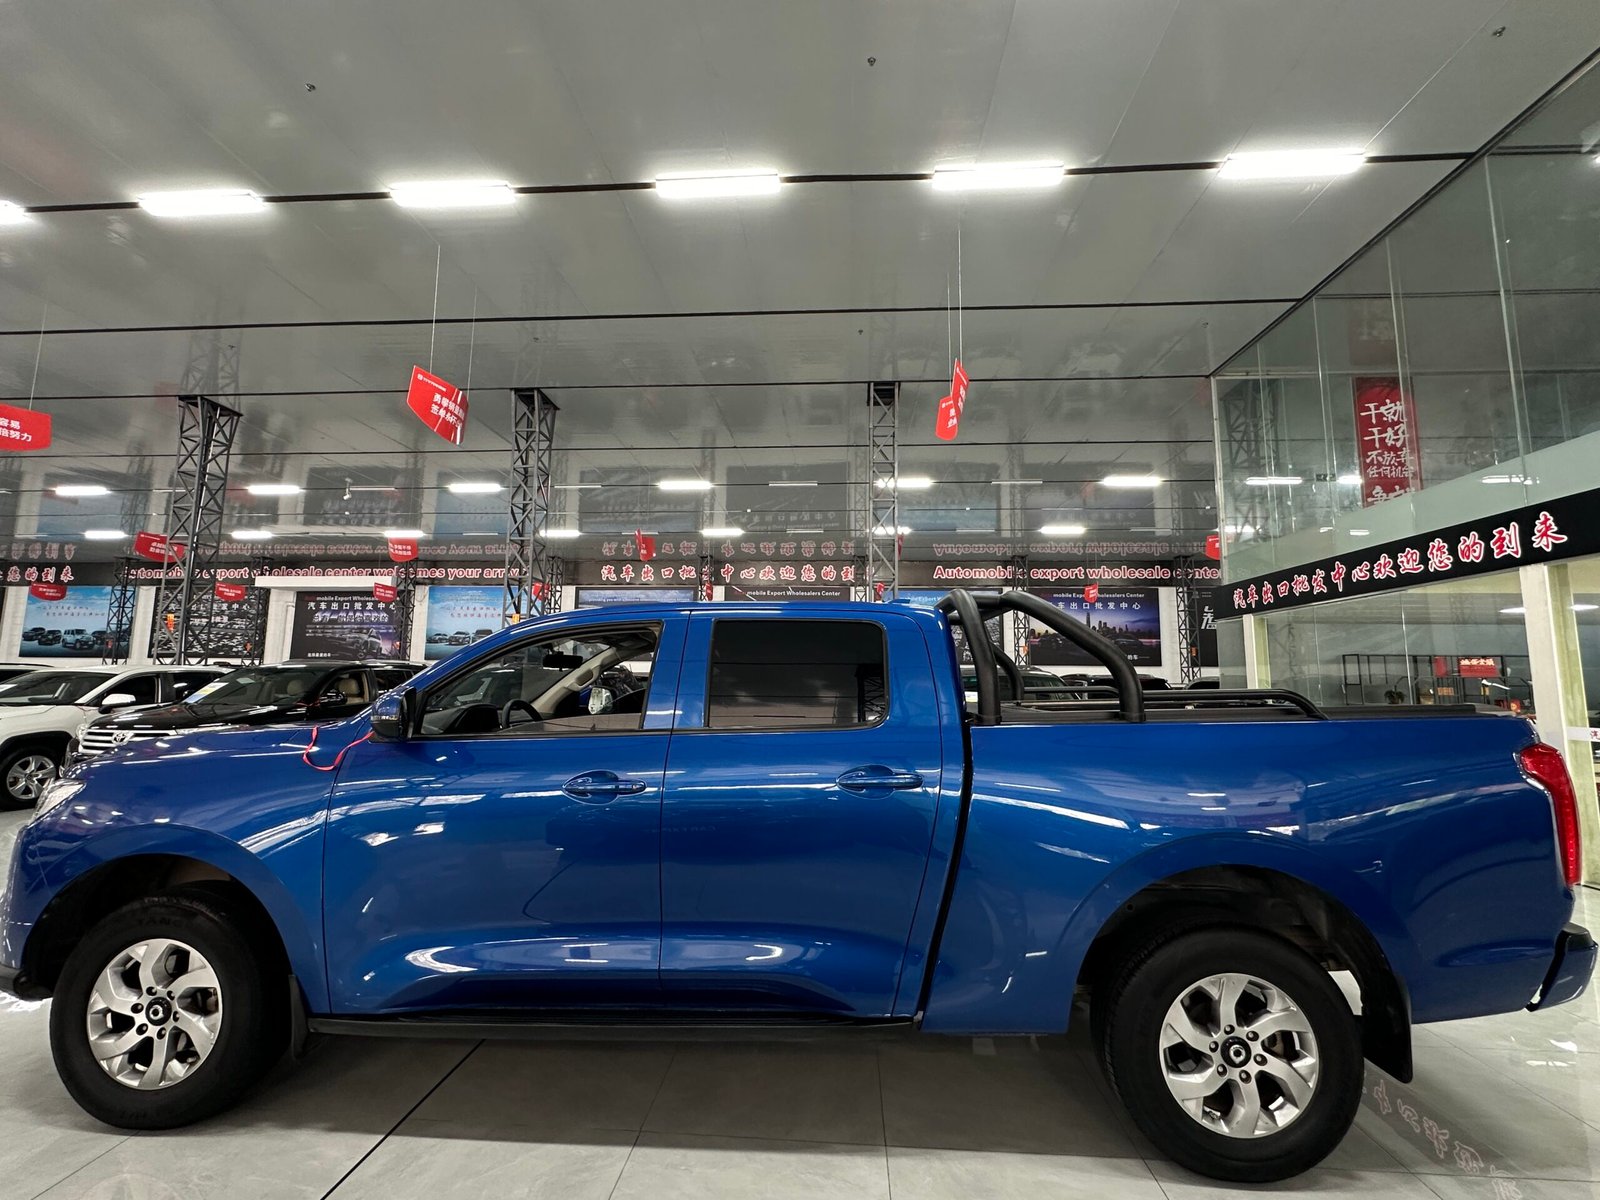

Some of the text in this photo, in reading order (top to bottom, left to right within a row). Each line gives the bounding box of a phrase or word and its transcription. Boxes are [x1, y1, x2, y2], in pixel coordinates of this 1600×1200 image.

[1233, 511, 1567, 609] 汽车出口批发中心欢迎您的到来
[0, 565, 74, 582] 您的到来
[448, 567, 481, 581] your
[1030, 567, 1084, 582] export
[1087, 565, 1170, 580] wholesale
[1049, 601, 1141, 611] 车出口批发中心
